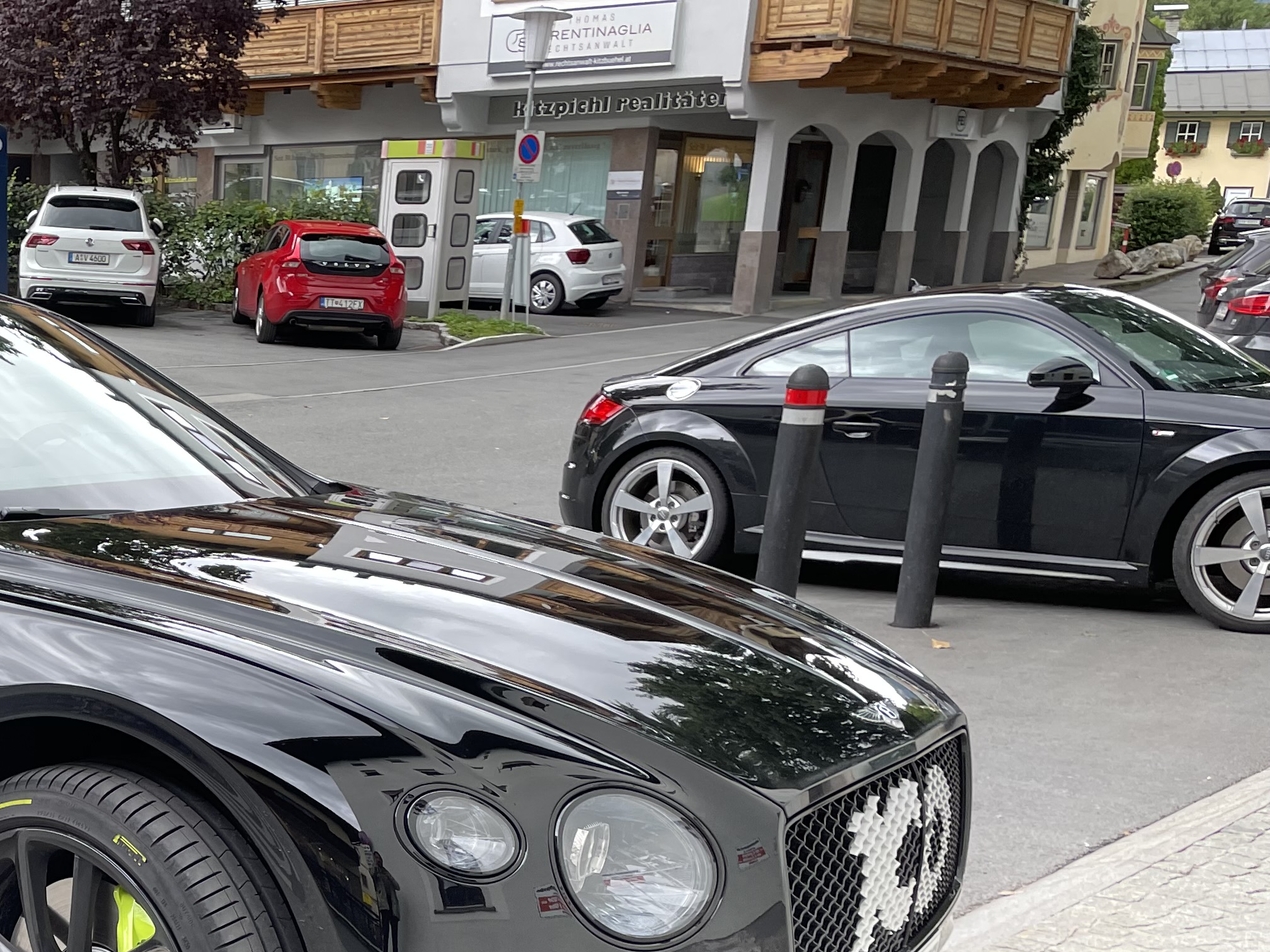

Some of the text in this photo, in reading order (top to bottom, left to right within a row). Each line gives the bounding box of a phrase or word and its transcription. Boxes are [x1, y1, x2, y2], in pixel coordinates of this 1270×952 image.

[551, 23, 653, 40] RENTINAGLIA
[513, 96, 611, 119] ktzpichl
[322, 261, 370, 269] VOLVO
